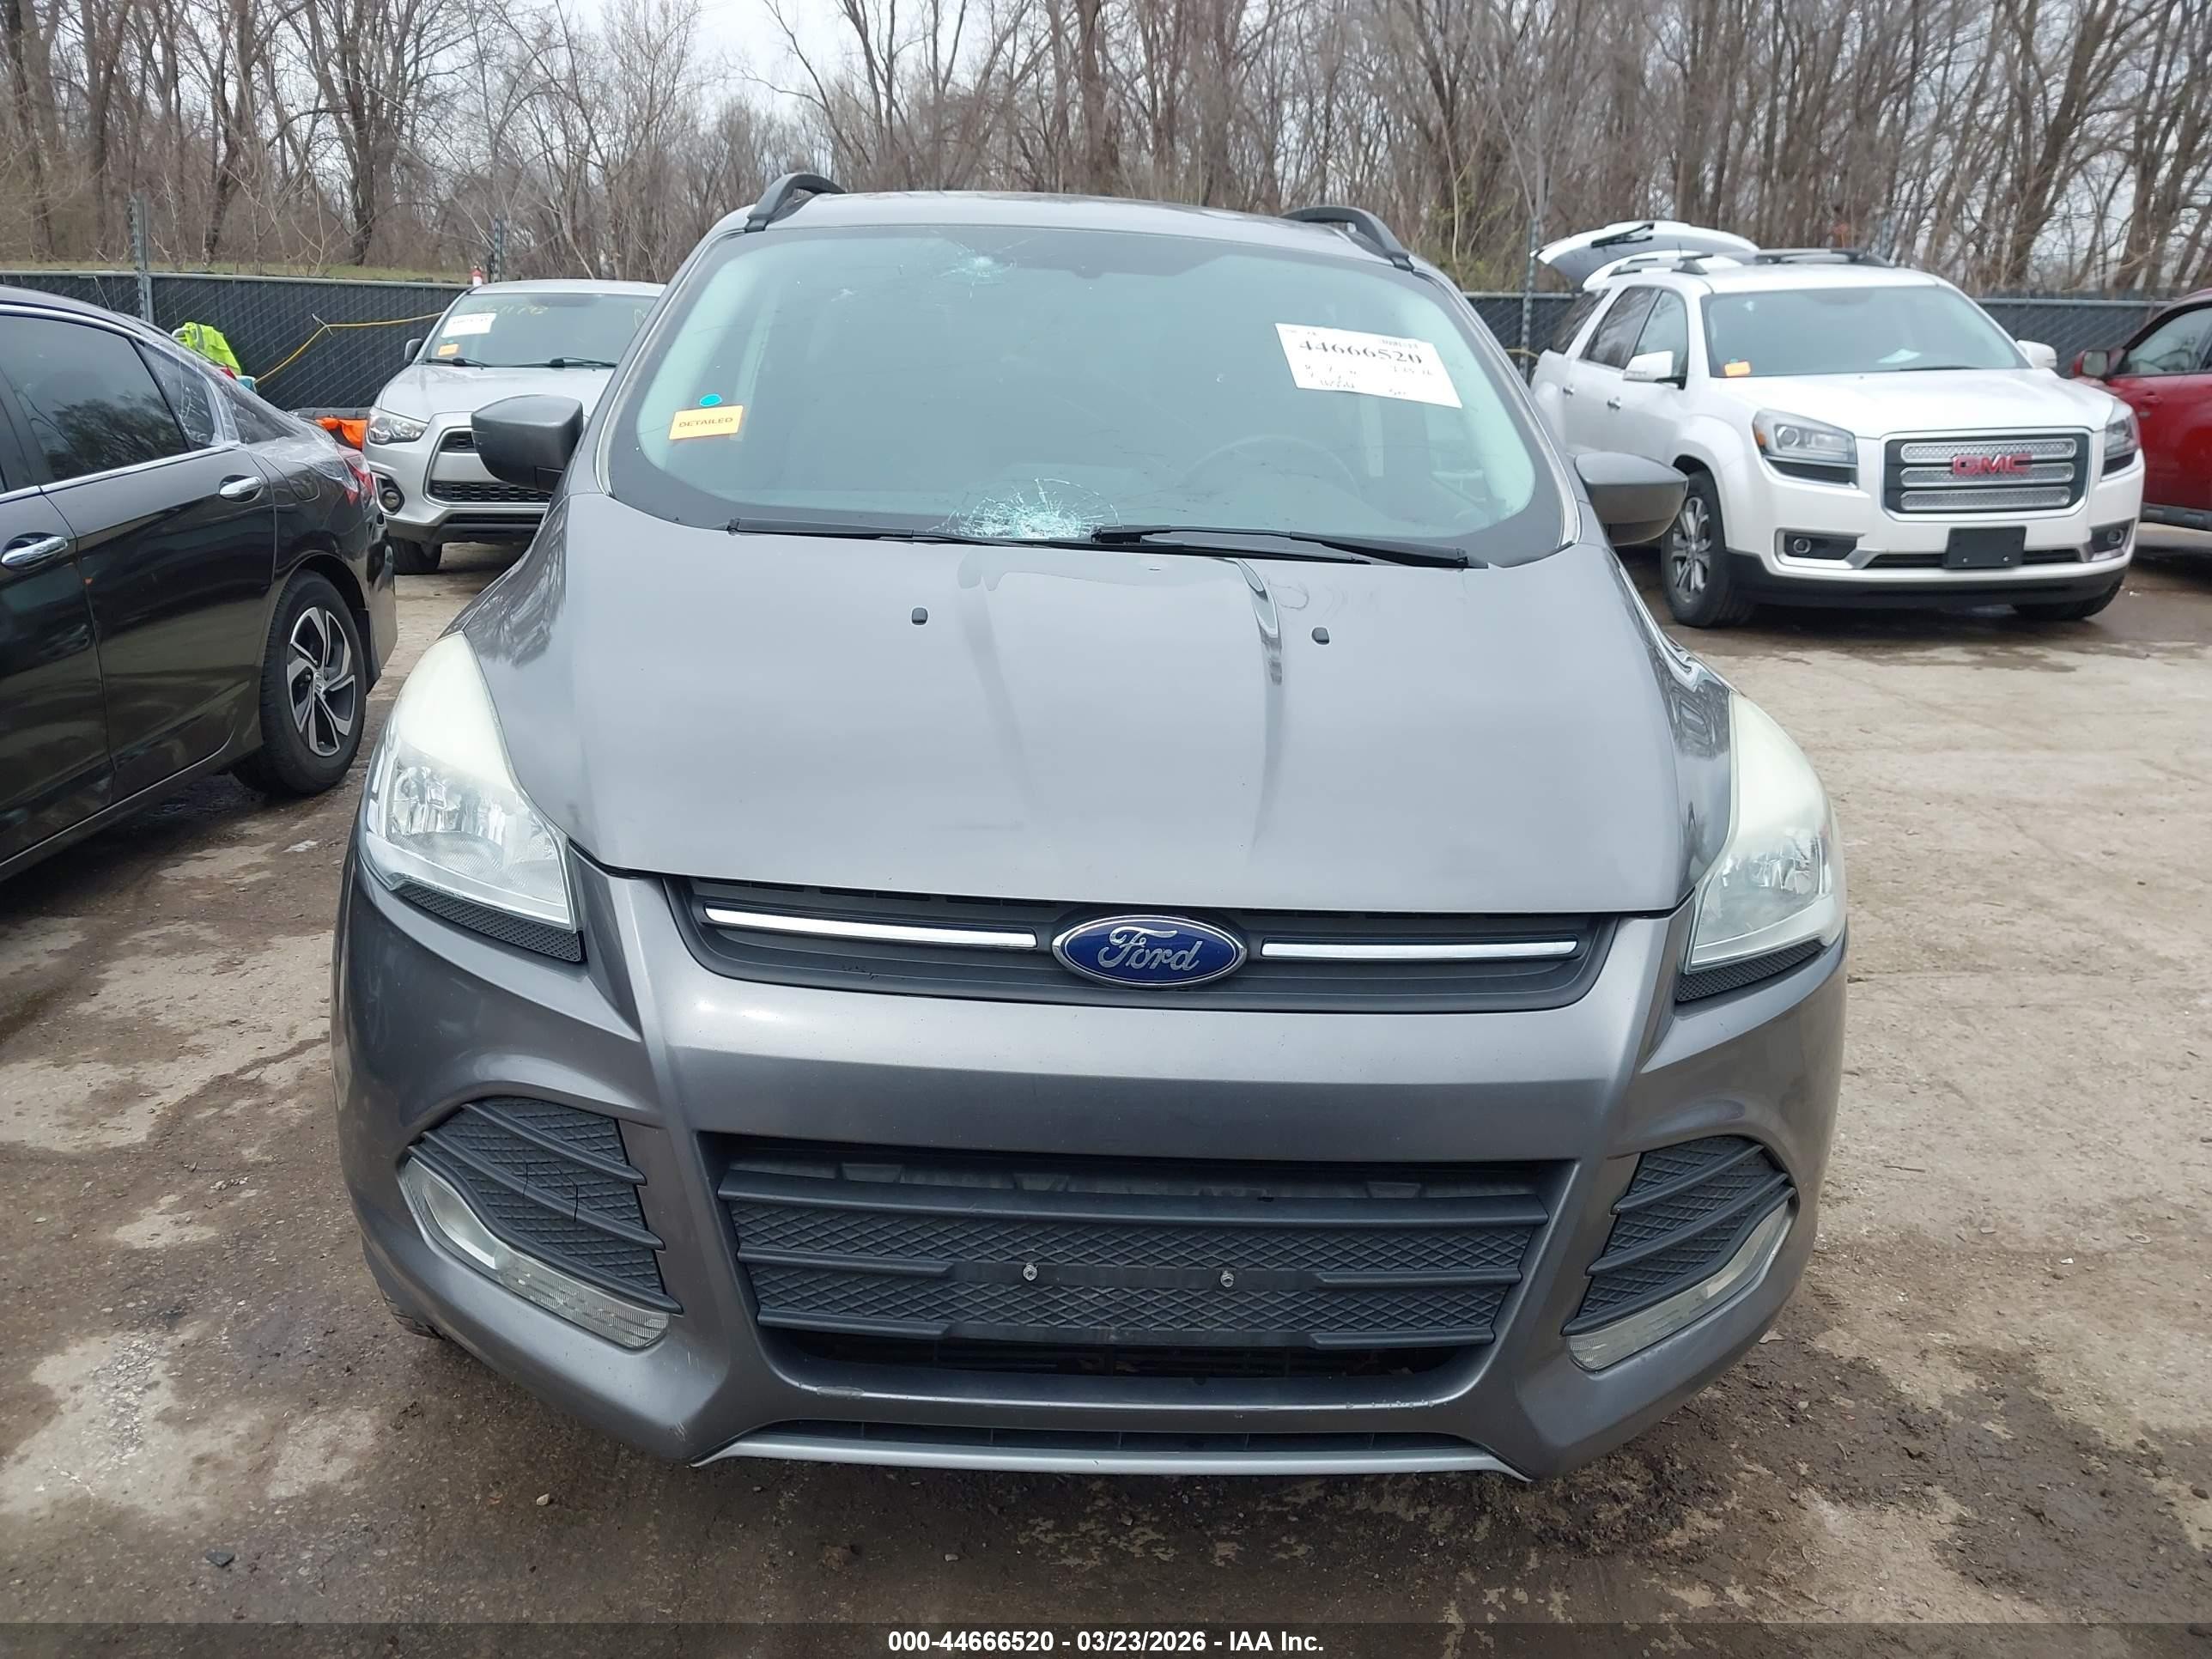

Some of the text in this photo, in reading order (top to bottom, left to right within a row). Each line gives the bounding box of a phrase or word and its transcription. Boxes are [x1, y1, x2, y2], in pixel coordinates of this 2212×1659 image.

[1298, 339, 1423, 365] 44666520
[679, 417, 733, 428] DETAILED
[1951, 453, 2033, 476] GMC
[1097, 926, 1203, 971] Ford
